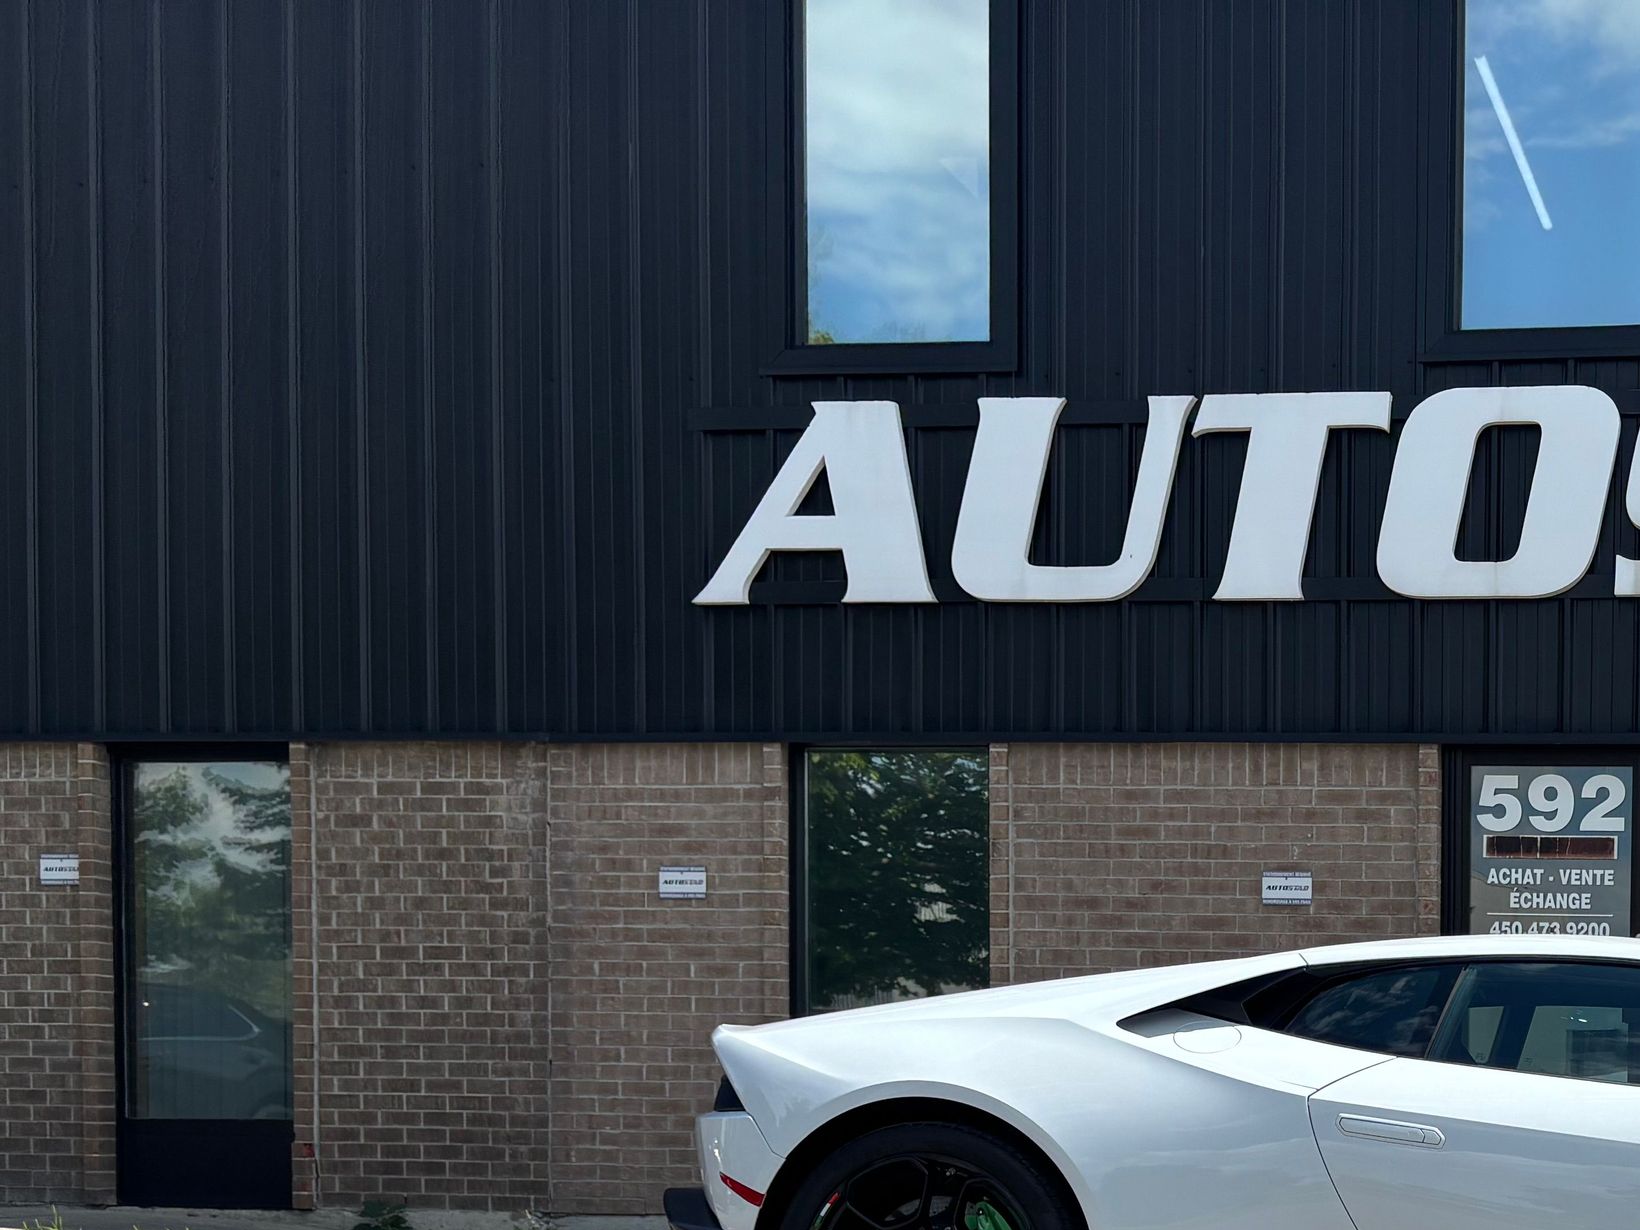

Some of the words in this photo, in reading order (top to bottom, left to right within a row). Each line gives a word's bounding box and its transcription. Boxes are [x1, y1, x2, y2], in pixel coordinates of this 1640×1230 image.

[1475, 773, 1627, 833] 592
[1487, 868, 1545, 885] ACHAT
[1559, 869, 1615, 886] VENTE
[1509, 887, 1592, 910] ÉCHANGE
[1489, 920, 1611, 936] 450.4739200
